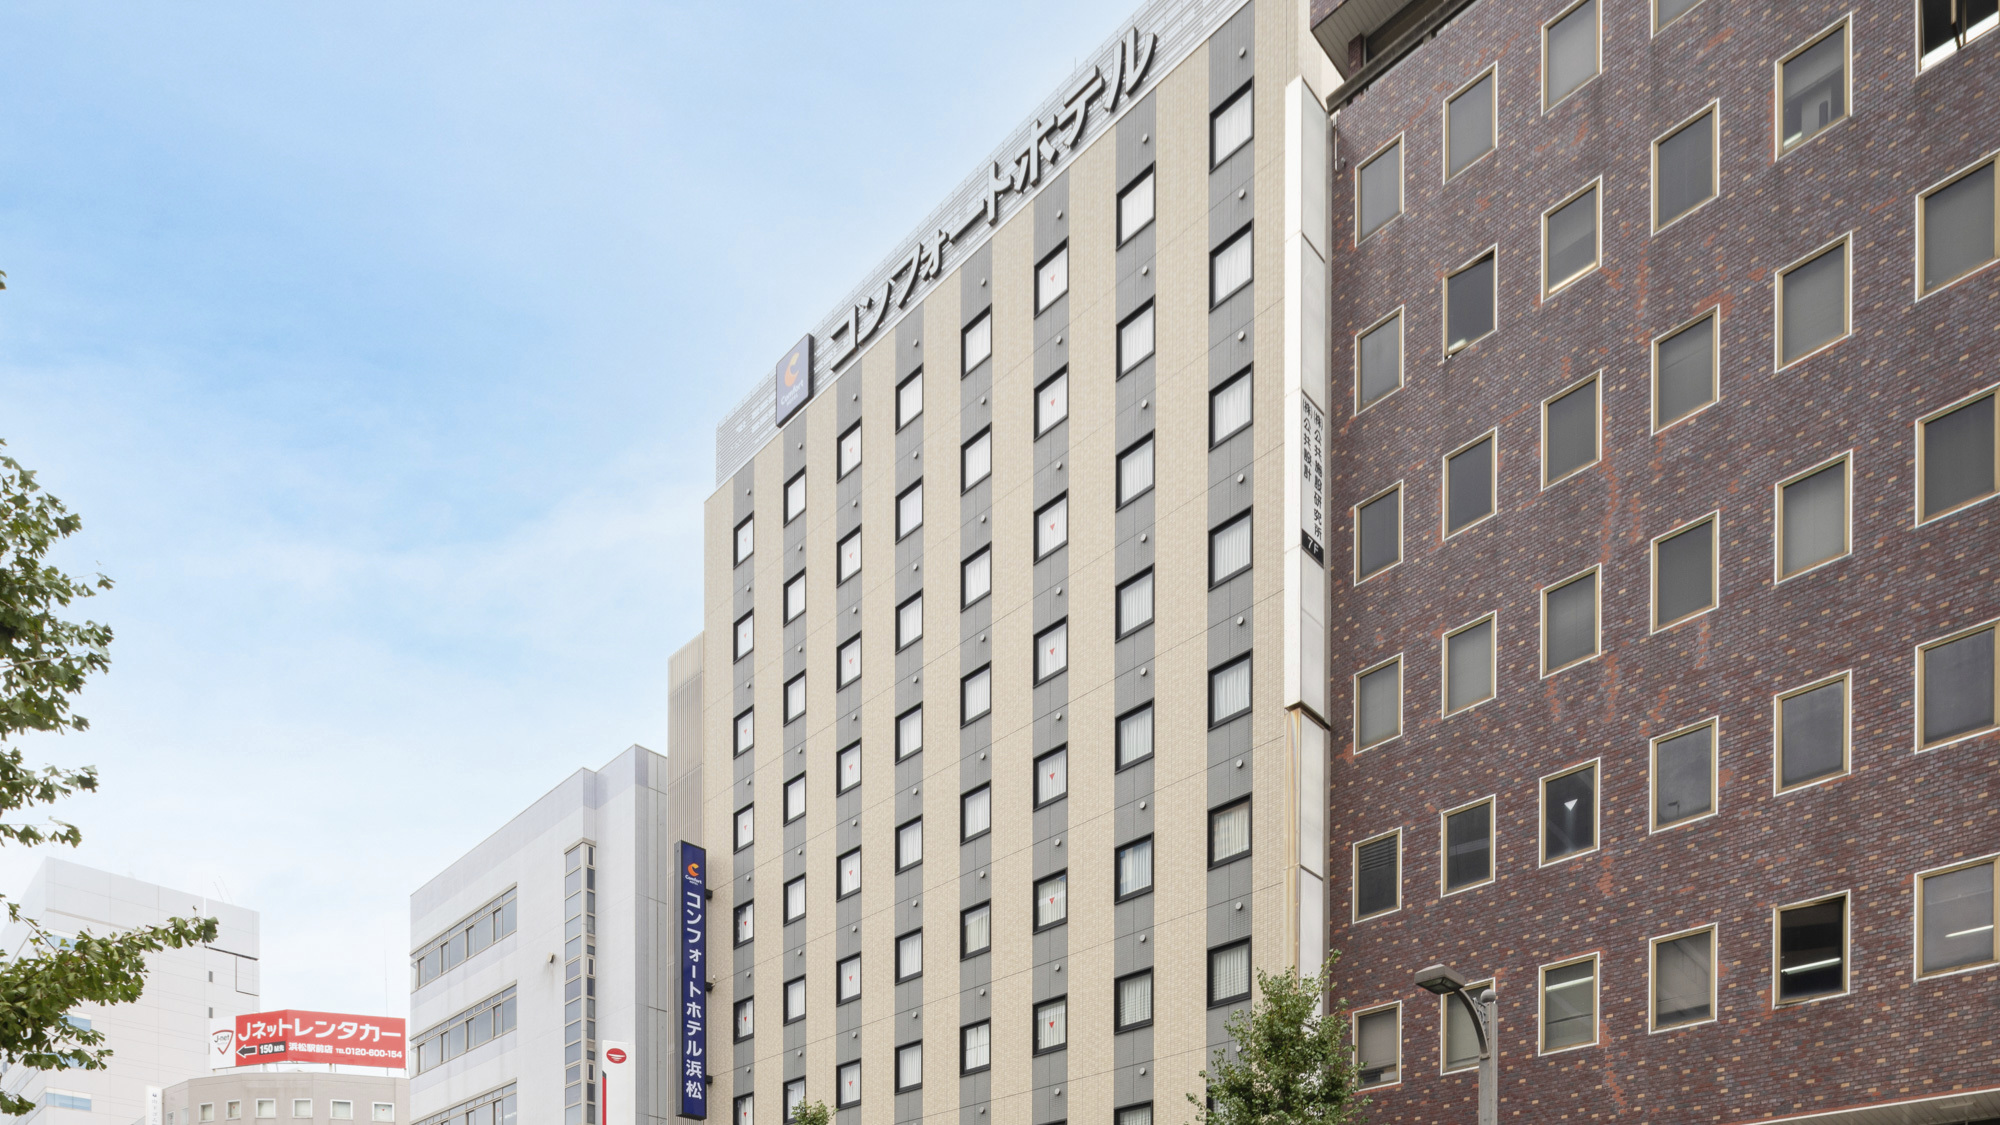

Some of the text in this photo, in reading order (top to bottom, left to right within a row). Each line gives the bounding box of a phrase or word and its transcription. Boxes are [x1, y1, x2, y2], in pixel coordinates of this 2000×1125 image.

[830, 26, 1157, 372] コンフォートホテル
[1307, 536, 1319, 554] 7F
[684, 874, 702, 884] Comfort
[686, 891, 703, 1100] コンフォートホテル浜松
[237, 1018, 402, 1042] Jネットレンタカー
[288, 1042, 333, 1054] 浜松駅前店
